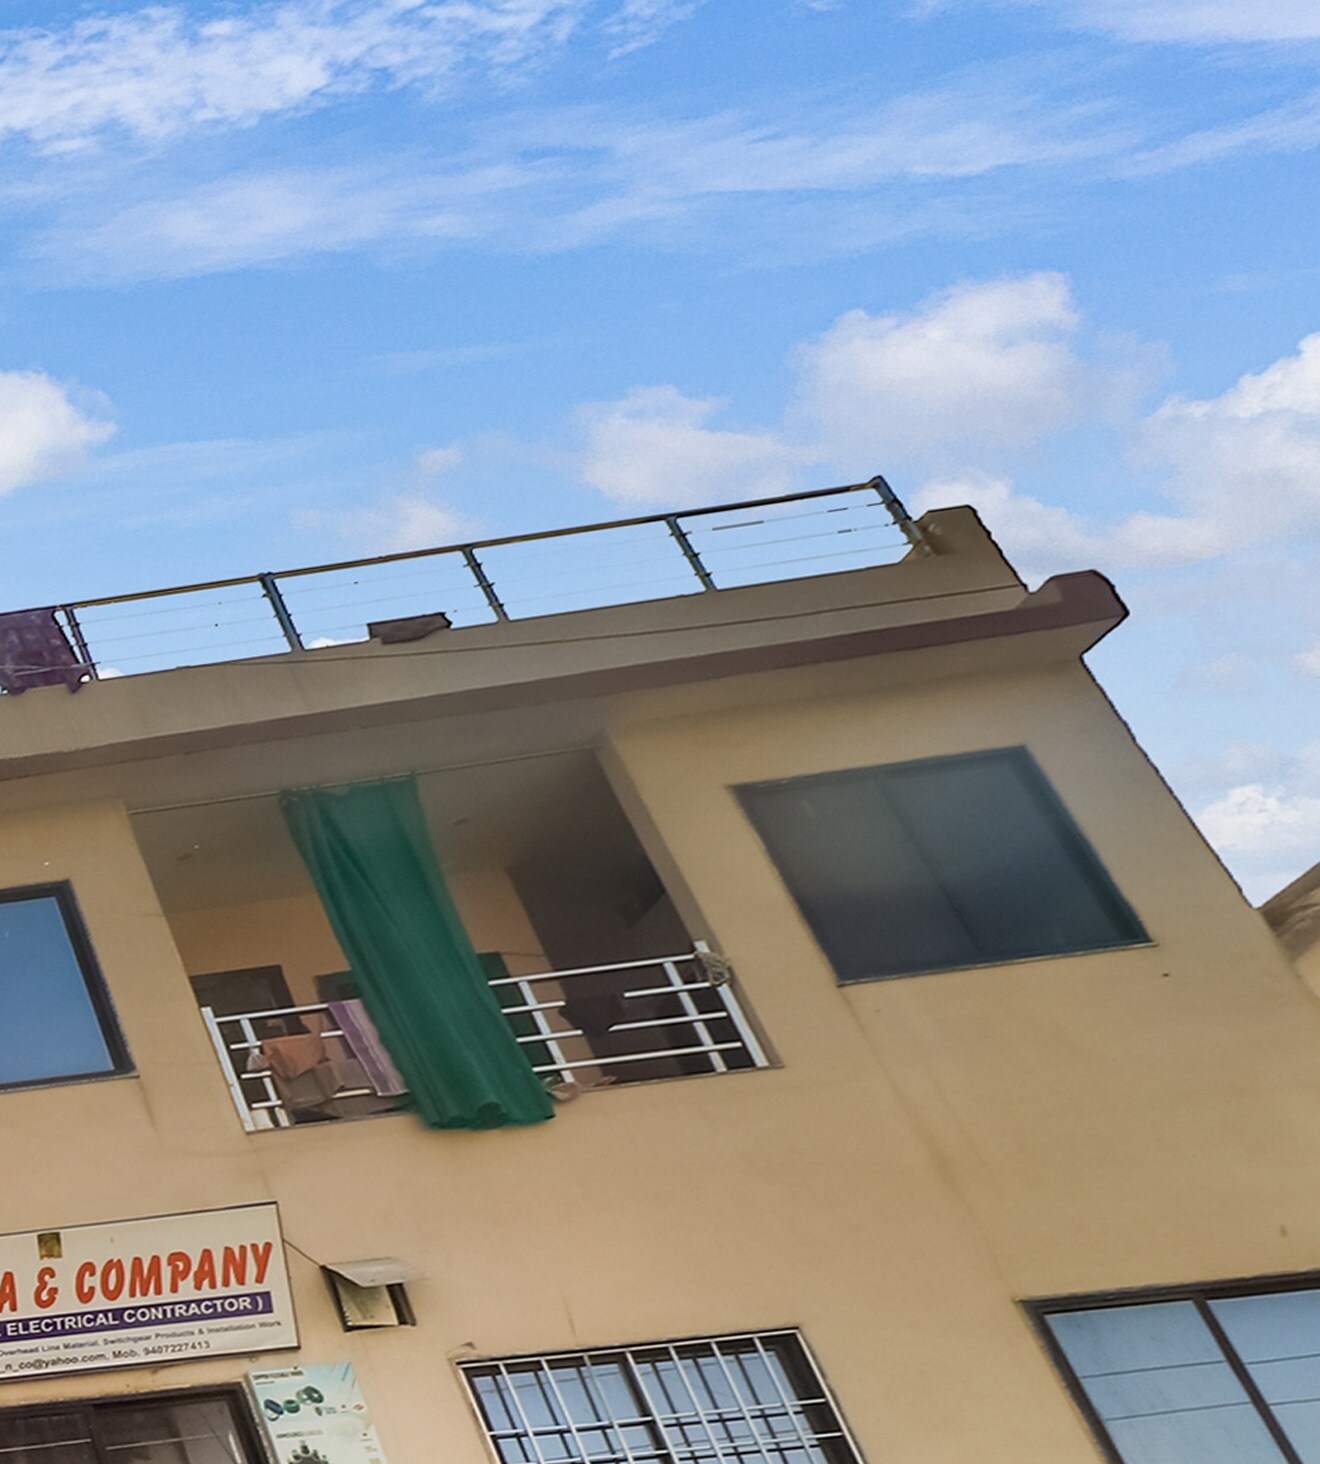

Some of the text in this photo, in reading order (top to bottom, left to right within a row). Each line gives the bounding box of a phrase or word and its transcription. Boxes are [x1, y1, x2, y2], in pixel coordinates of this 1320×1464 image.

[34, 1267, 59, 1309] &
[76, 1242, 272, 1303] COMPANY
[6, 1312, 120, 1336] ELECTRICAL
[41, 1343, 61, 1352] Line
[155, 1330, 195, 1340] Products
[112, 1349, 140, 1360] Mob.
